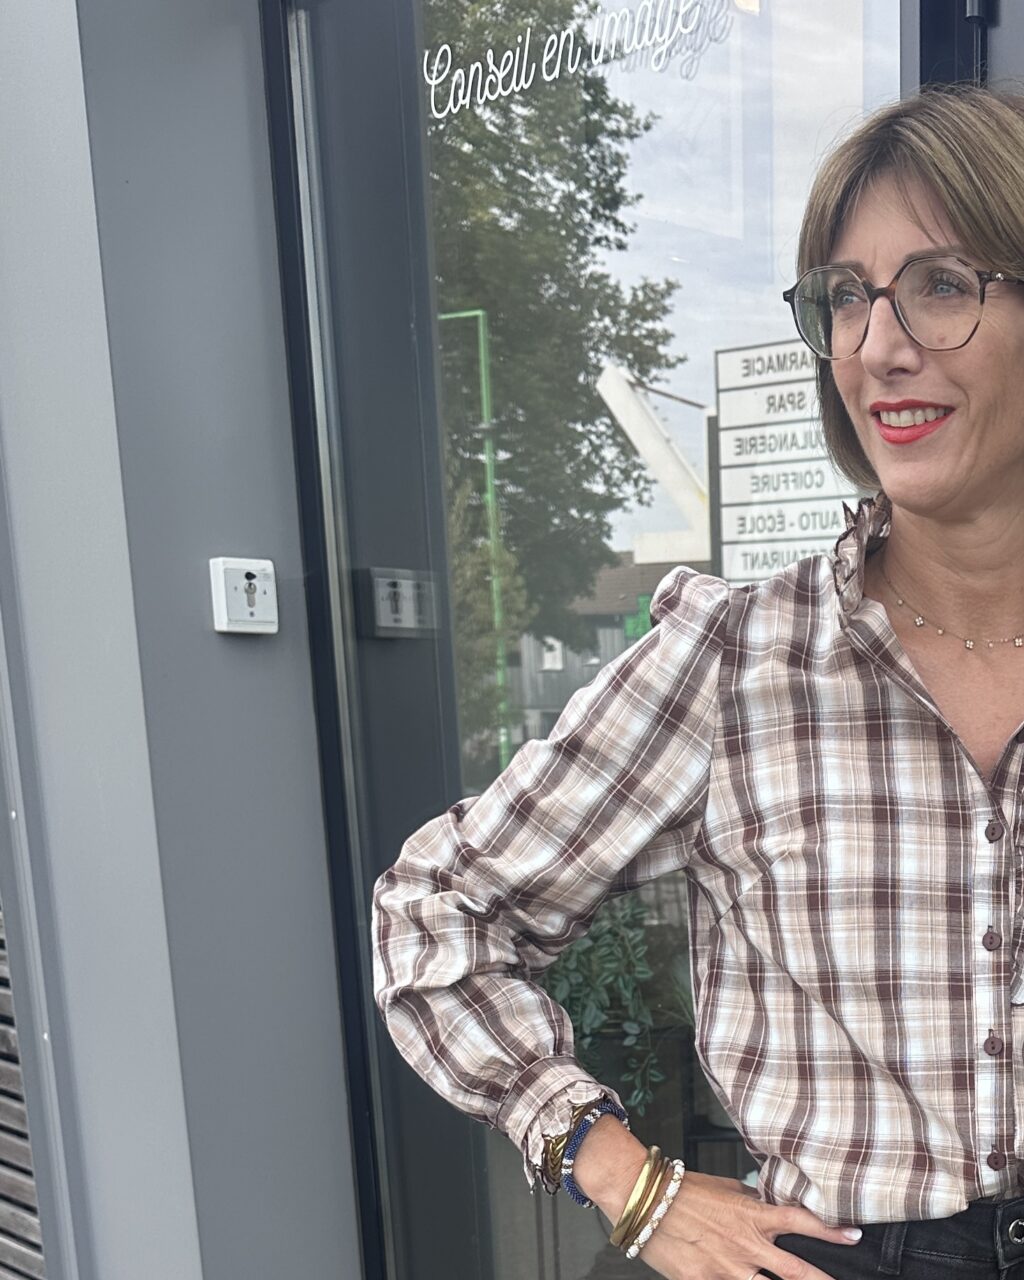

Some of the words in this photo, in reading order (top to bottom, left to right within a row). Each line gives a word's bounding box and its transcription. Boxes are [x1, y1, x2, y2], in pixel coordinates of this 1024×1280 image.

[423, 27, 536, 119] Conseil
[541, 27, 583, 82] en
[591, 0, 704, 72] image
